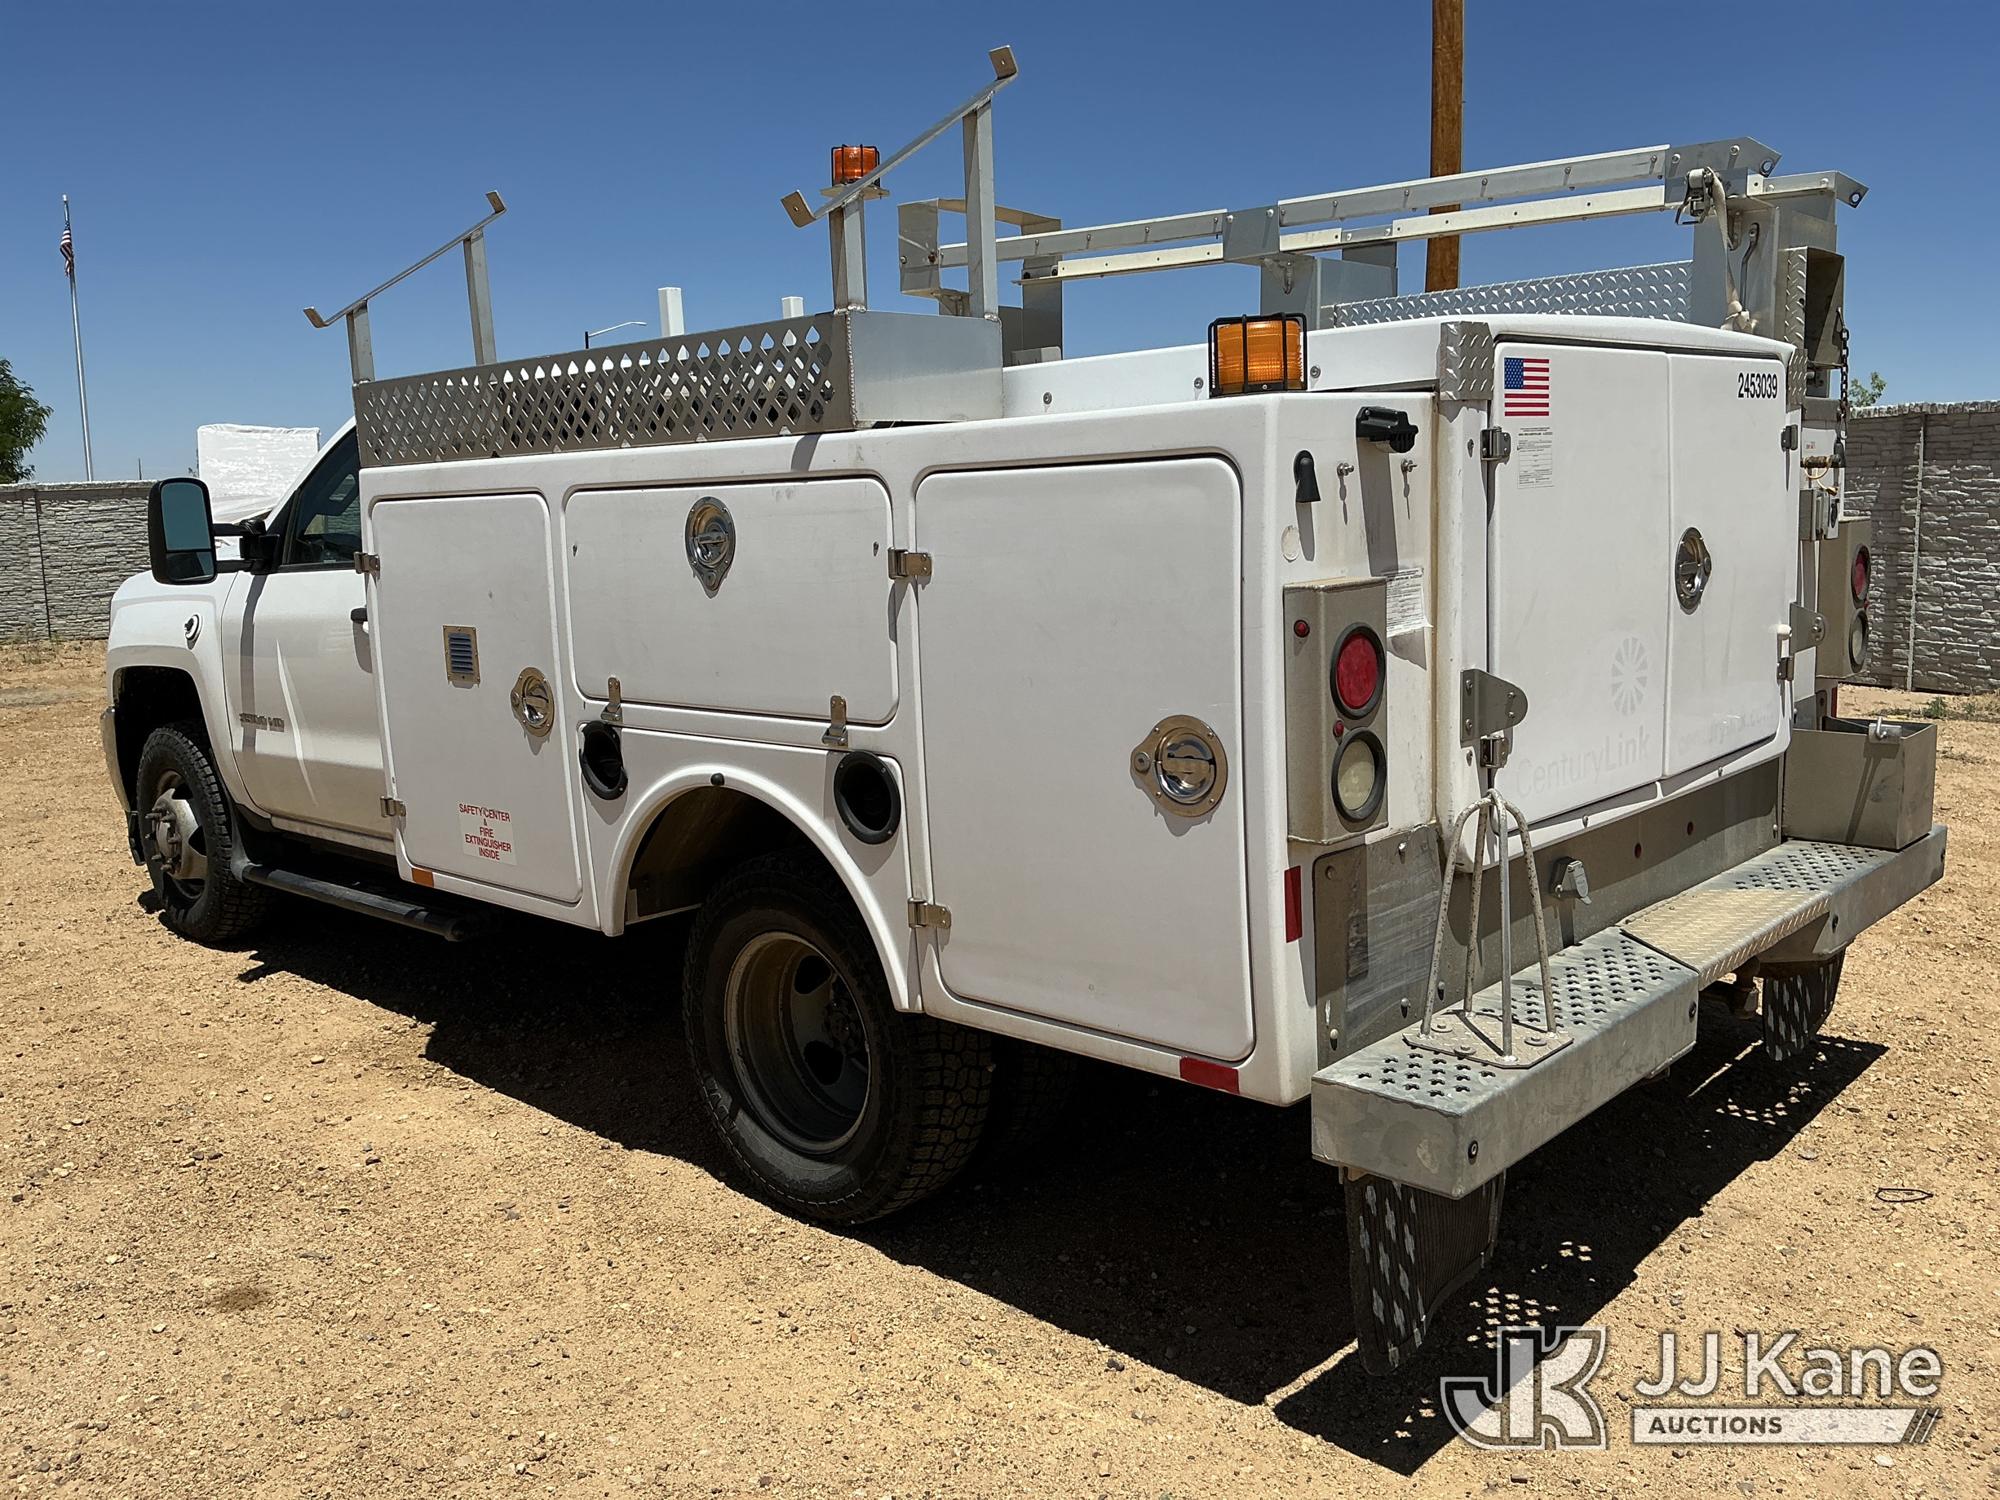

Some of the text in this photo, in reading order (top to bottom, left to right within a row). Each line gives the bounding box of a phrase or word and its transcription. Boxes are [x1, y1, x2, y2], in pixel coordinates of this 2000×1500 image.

[1738, 372, 1778, 399] 2453039
[1515, 723, 1650, 798] CenturyLink
[459, 803, 511, 822] SAFETY CENTER
[480, 827, 494, 838] FIRE
[465, 834, 512, 852] EXTINGUISHER
[479, 847, 500, 860] INSIDE
